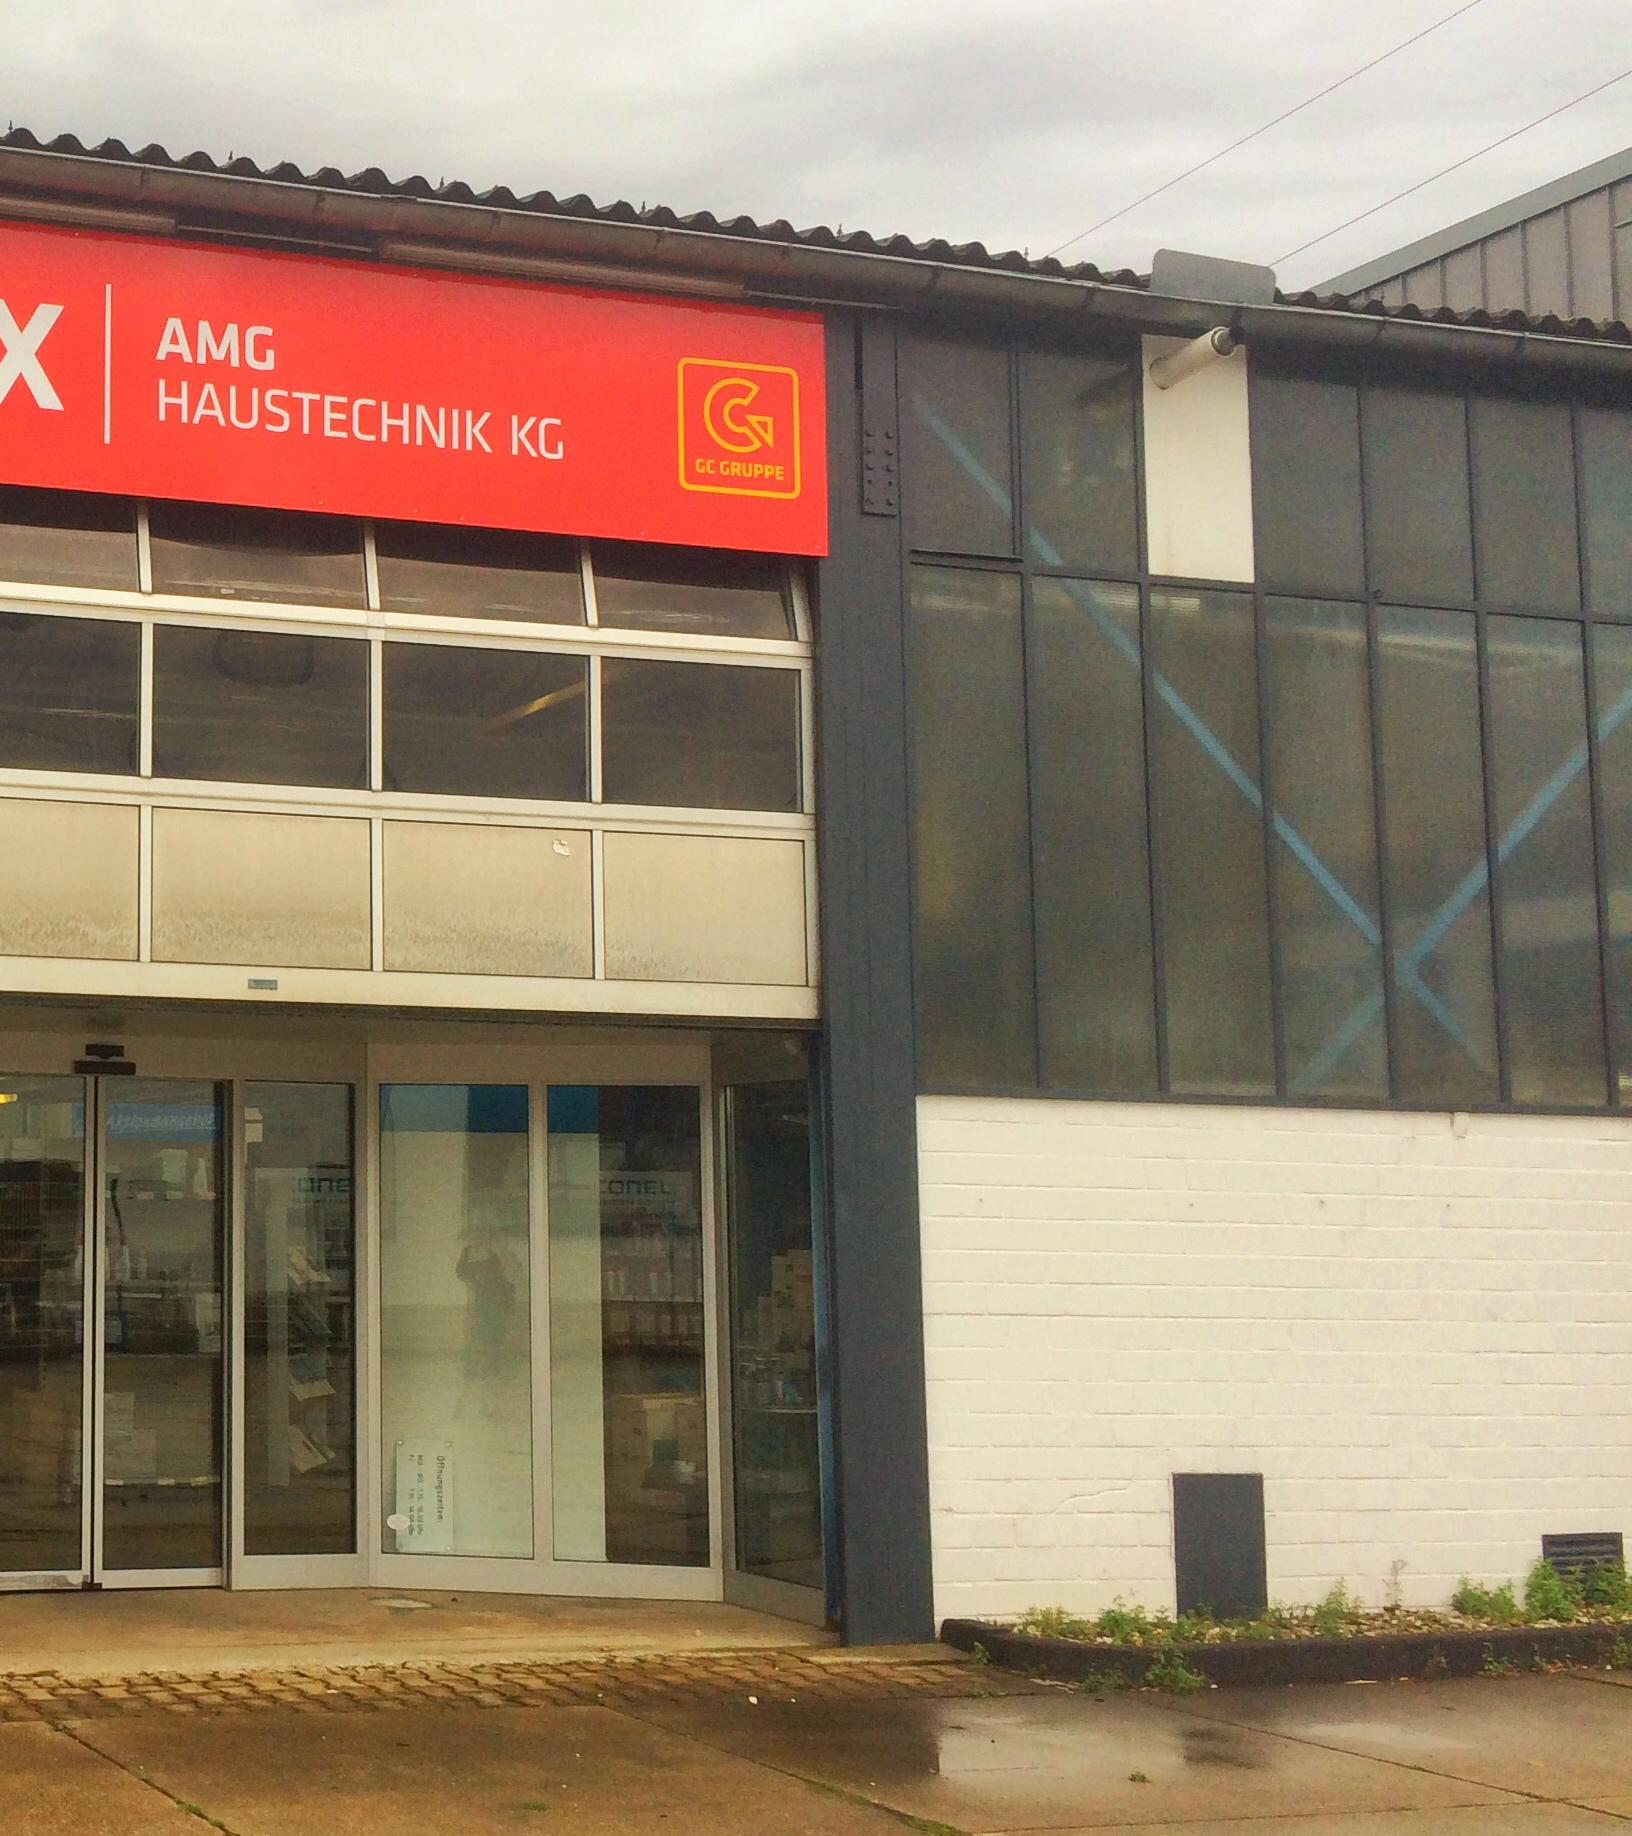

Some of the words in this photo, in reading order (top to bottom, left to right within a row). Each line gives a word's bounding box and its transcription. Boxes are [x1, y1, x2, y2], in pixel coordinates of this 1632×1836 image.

[155, 317, 275, 371] AMG
[158, 378, 493, 453] HAUSTECHNIK
[510, 414, 564, 460] KG
[695, 458, 715, 474] GC
[719, 461, 784, 481] GRUPPE
